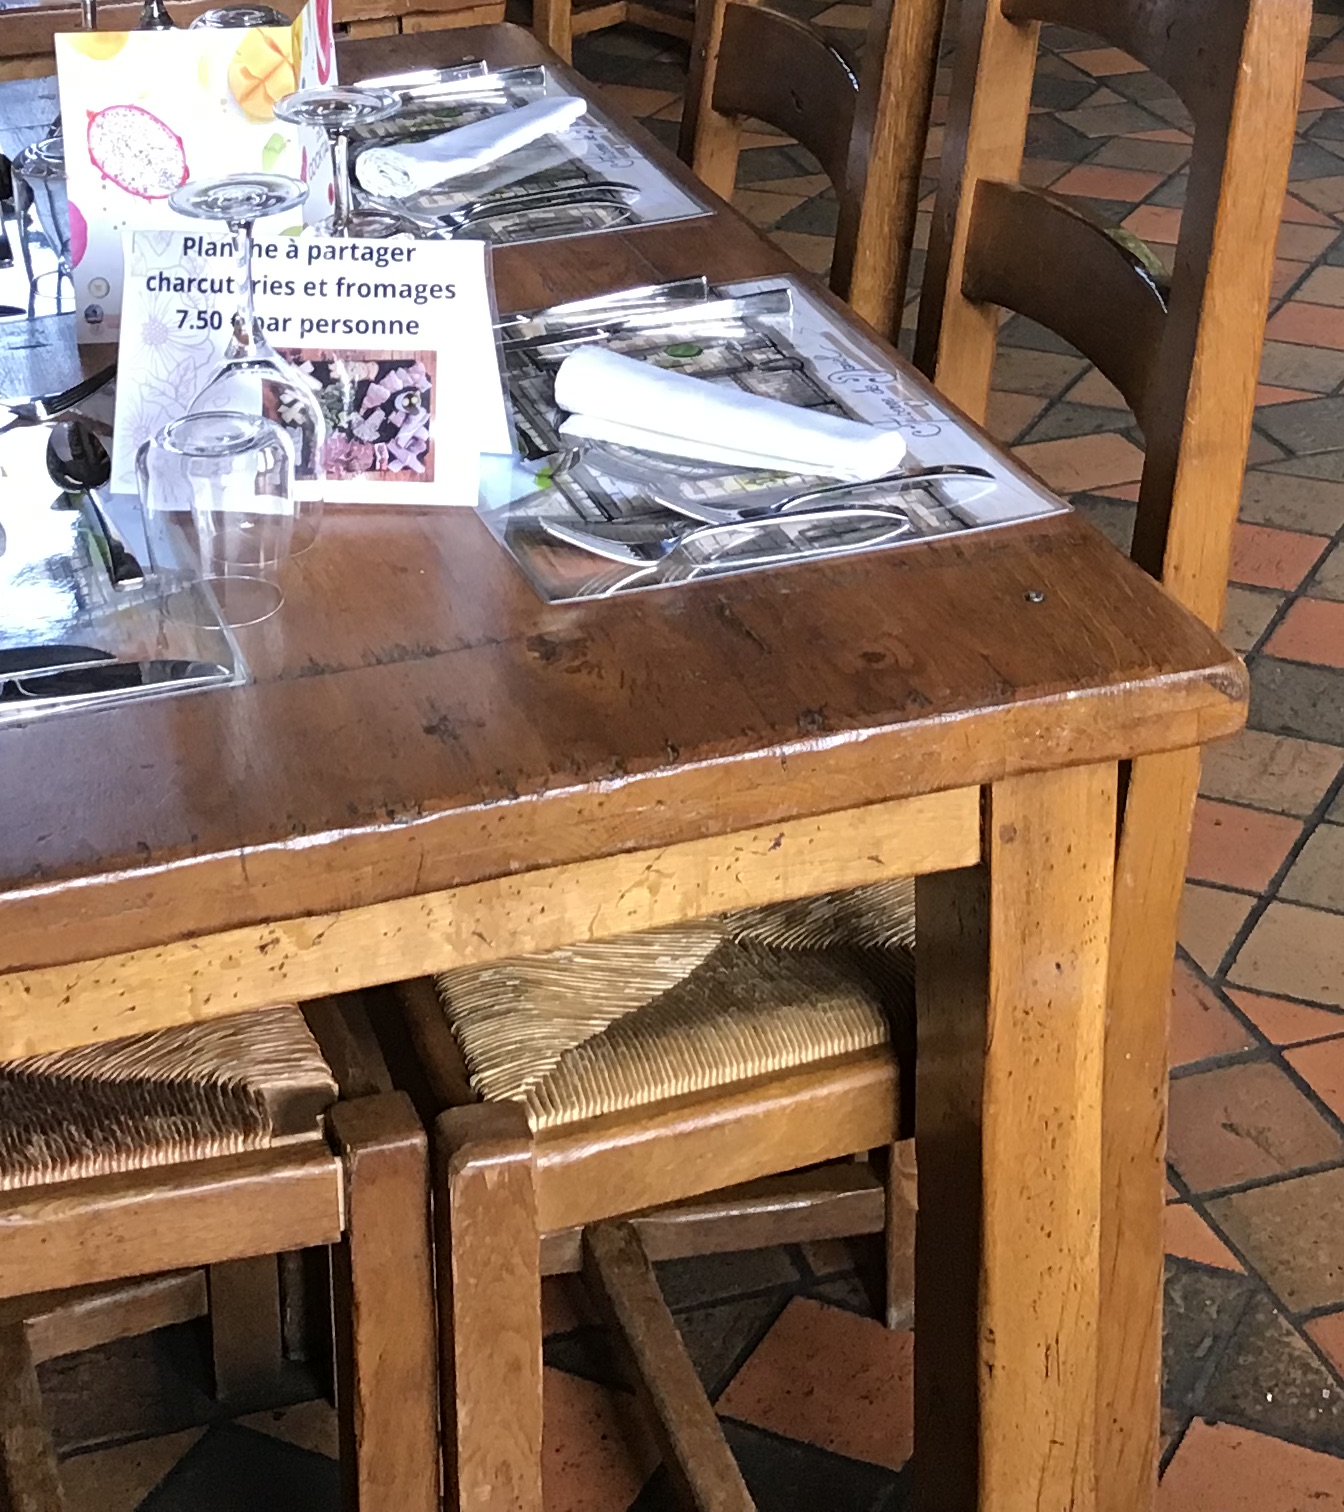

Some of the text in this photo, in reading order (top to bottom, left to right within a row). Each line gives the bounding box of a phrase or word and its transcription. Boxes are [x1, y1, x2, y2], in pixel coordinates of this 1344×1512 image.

[182, 236, 417, 268] Planhe à partager
[145, 271, 457, 306] charcutries et fromages
[175, 309, 223, 330] 7.50
[300, 317, 420, 340] personne
